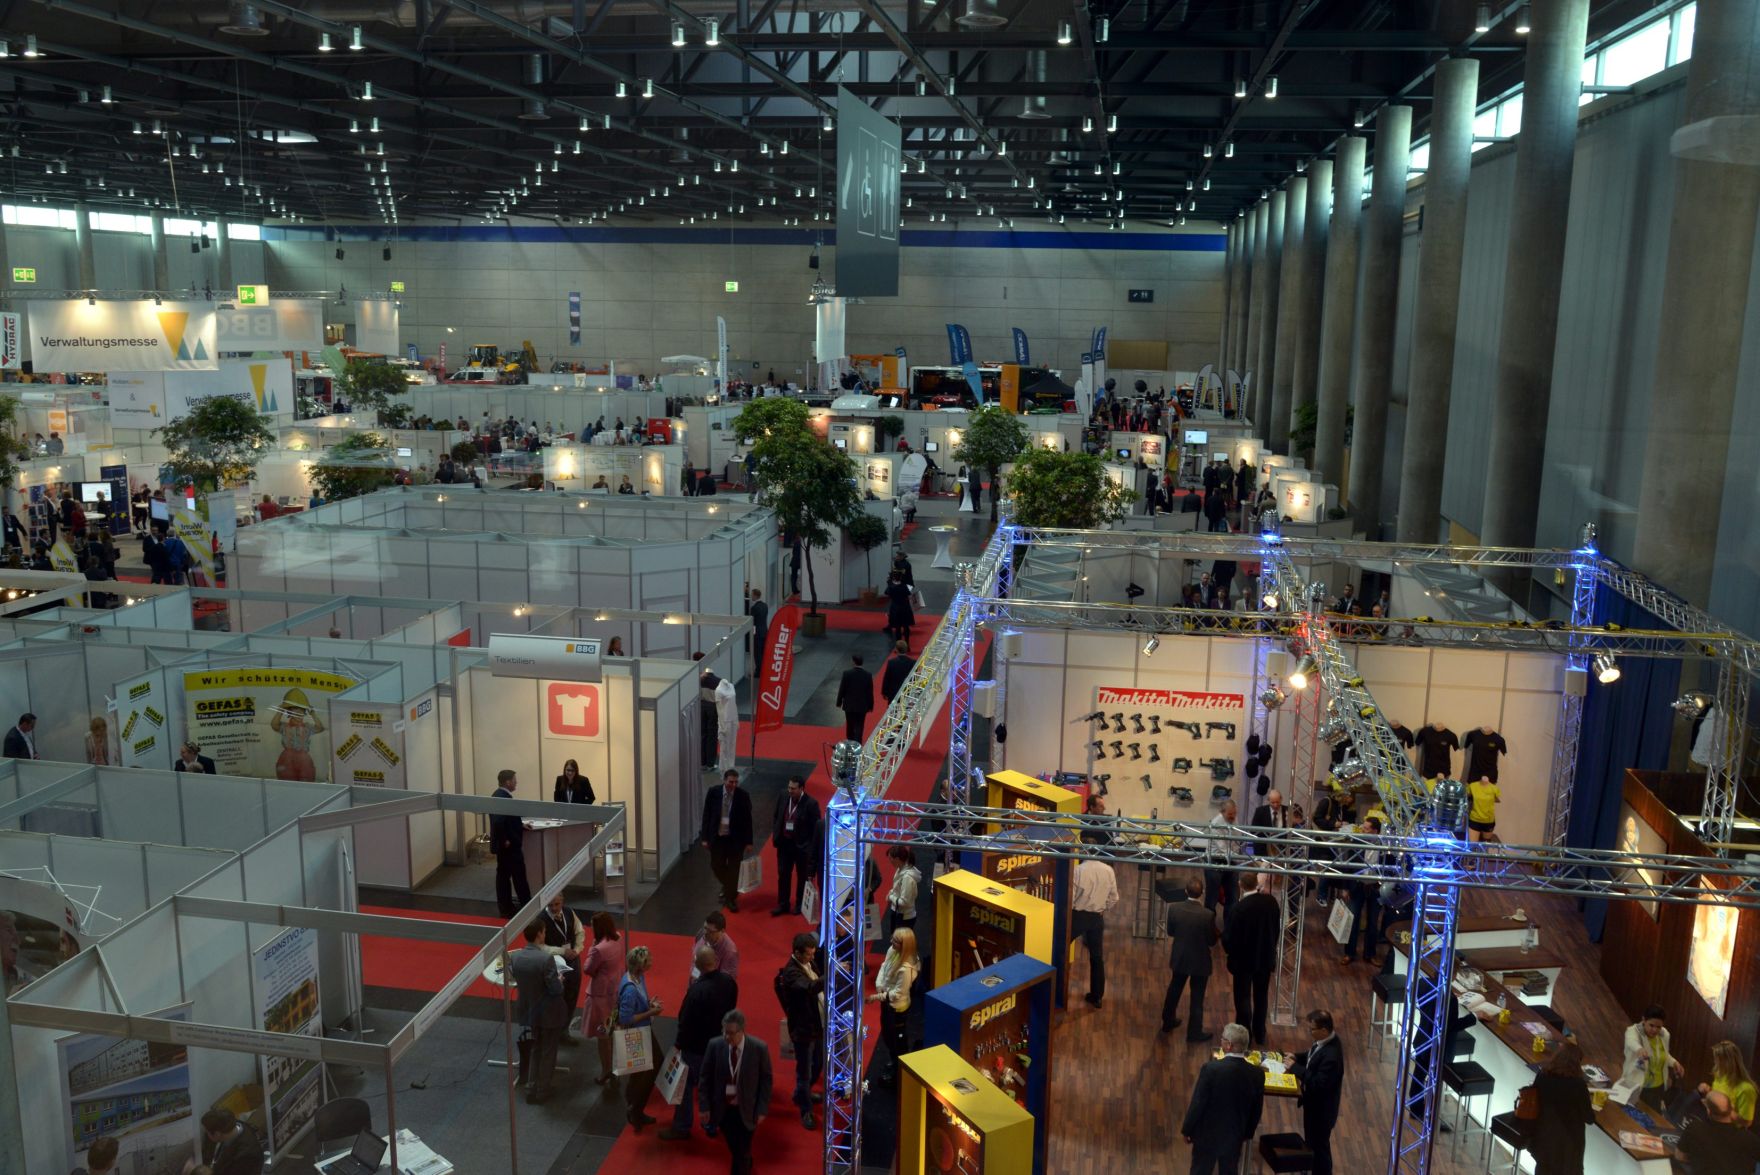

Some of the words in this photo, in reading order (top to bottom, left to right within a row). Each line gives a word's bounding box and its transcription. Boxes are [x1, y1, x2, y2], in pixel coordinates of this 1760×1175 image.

[41, 336, 158, 348] Verwaltungsmesse
[577, 645, 595, 653] BBG
[770, 624, 789, 682] Löffler
[495, 656, 535, 665] Textilien
[197, 700, 241, 711] GEFAS
[418, 702, 431, 716] BBG
[997, 854, 1042, 873] spiral
[969, 905, 1016, 934] spiral
[264, 929, 300, 961] JEDINSTVO
[970, 993, 1016, 1028] spiral
